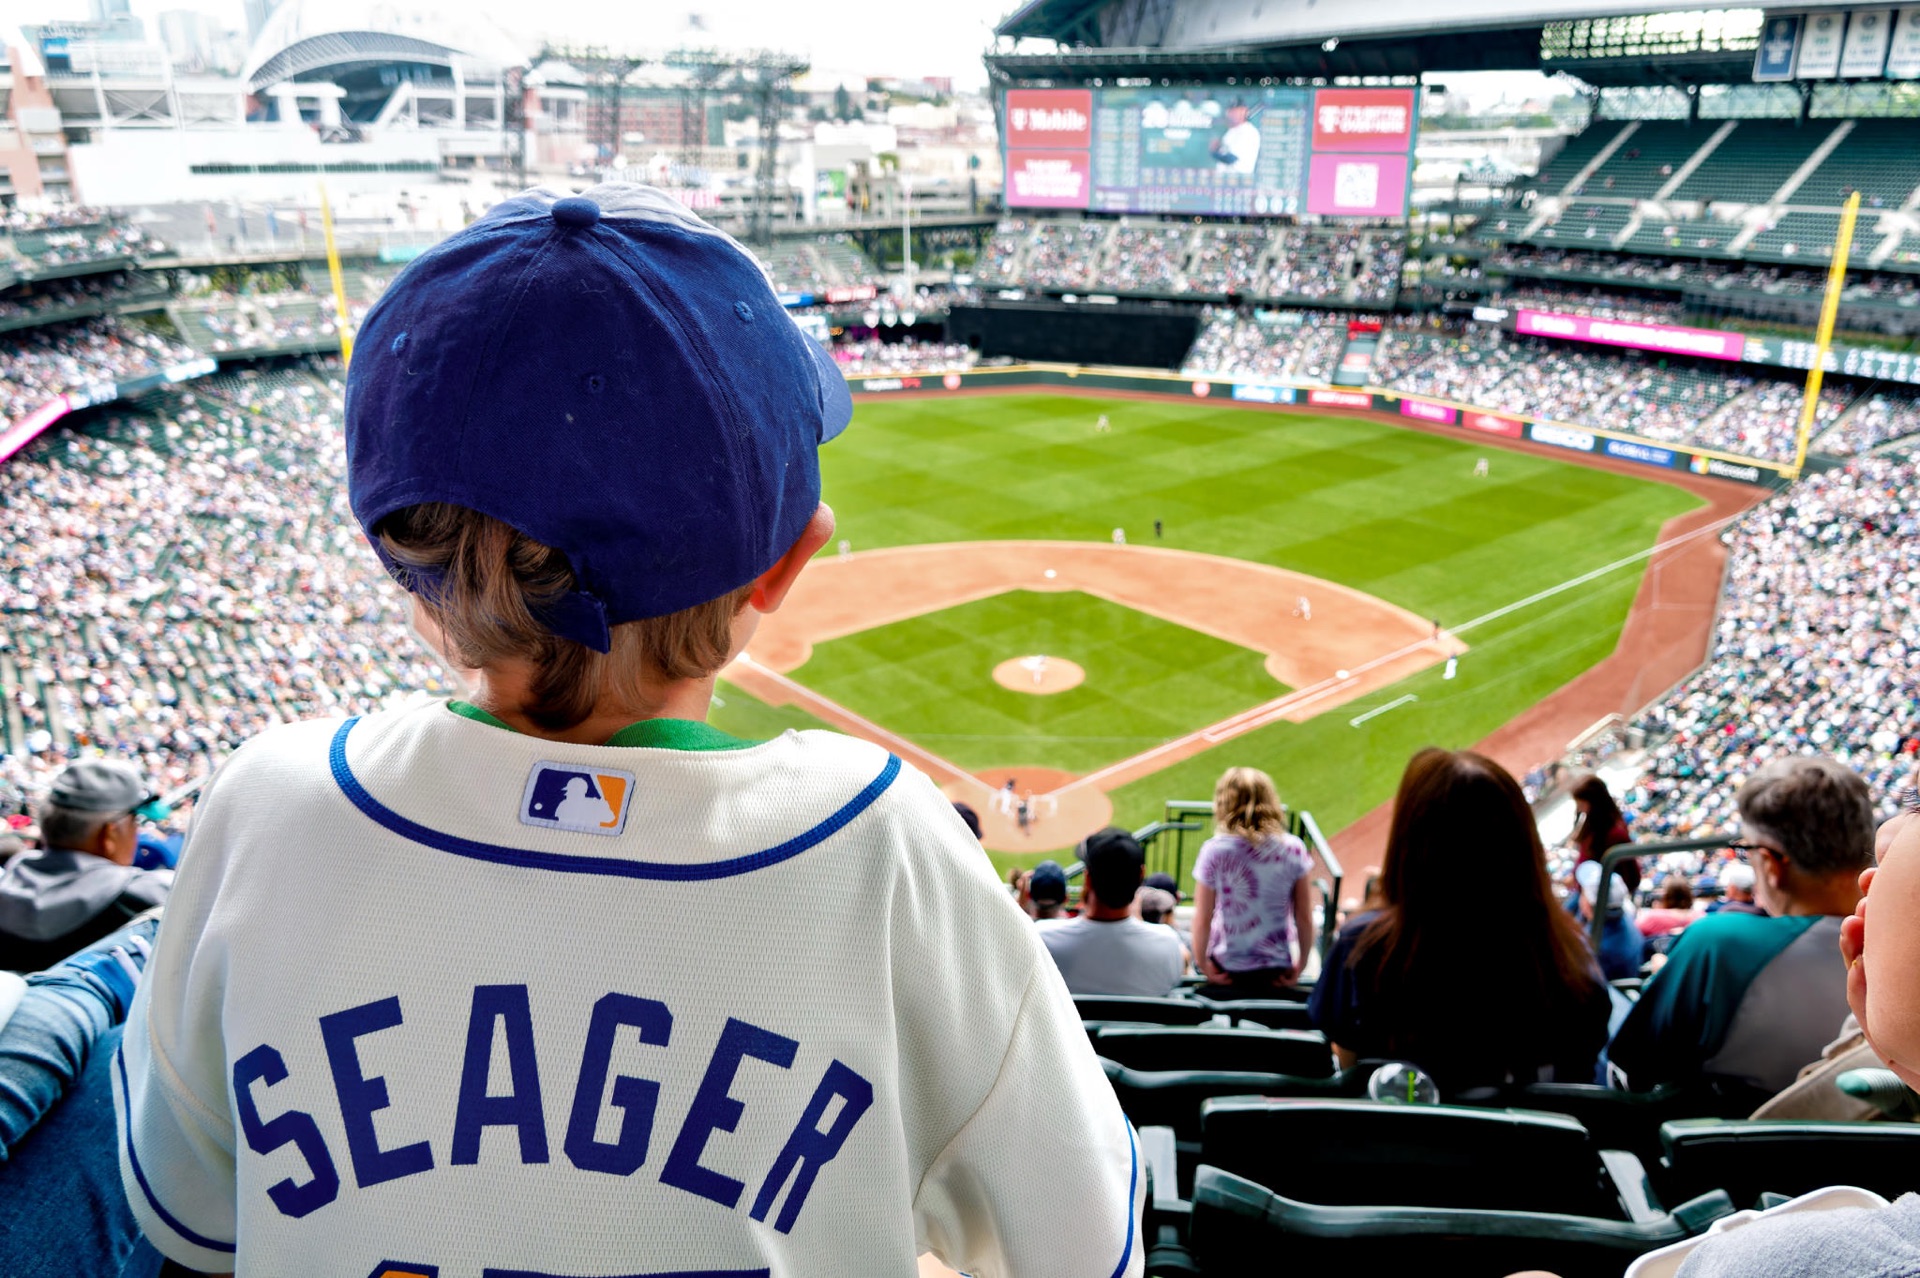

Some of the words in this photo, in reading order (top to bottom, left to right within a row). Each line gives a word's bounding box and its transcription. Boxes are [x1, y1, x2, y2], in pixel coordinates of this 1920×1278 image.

[1029, 108, 1087, 131] Mobile
[1709, 459, 1759, 482] Microsoft
[233, 984, 874, 1235] SEAGER
